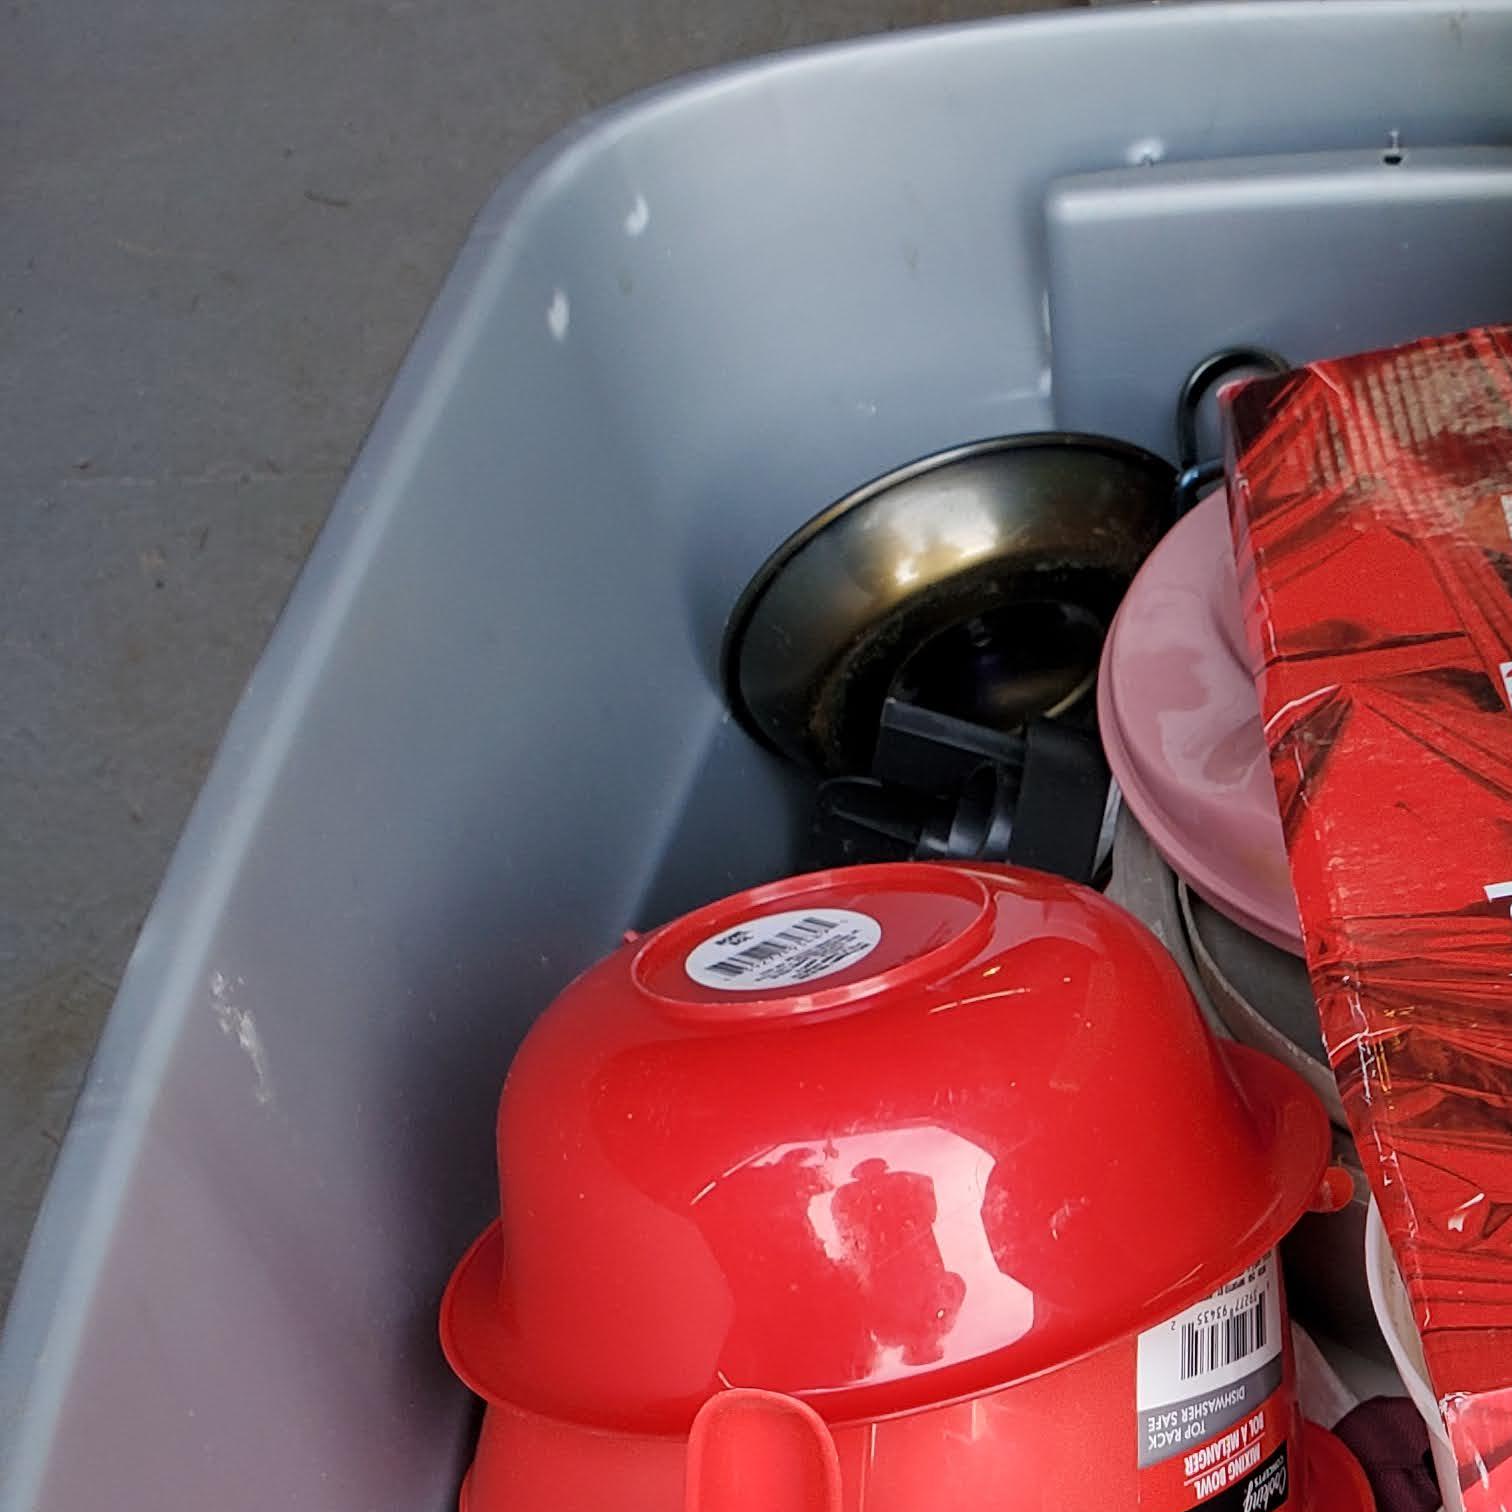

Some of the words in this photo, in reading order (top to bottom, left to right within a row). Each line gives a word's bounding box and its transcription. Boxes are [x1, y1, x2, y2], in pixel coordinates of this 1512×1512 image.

[1197, 1305, 1227, 1326] 93435
[1148, 1408, 1178, 1432] SAFE
[1181, 1385, 1246, 1423] DISHWASHER
[1148, 1428, 1182, 1450] RACK
[1184, 1421, 1206, 1439] TOP
[1184, 1430, 1240, 1476] MÉLANGER
[1228, 1442, 1261, 1480] MIXING
[1194, 1467, 1226, 1499] BOWL
[1254, 1455, 1284, 1487] CONCEPTS
